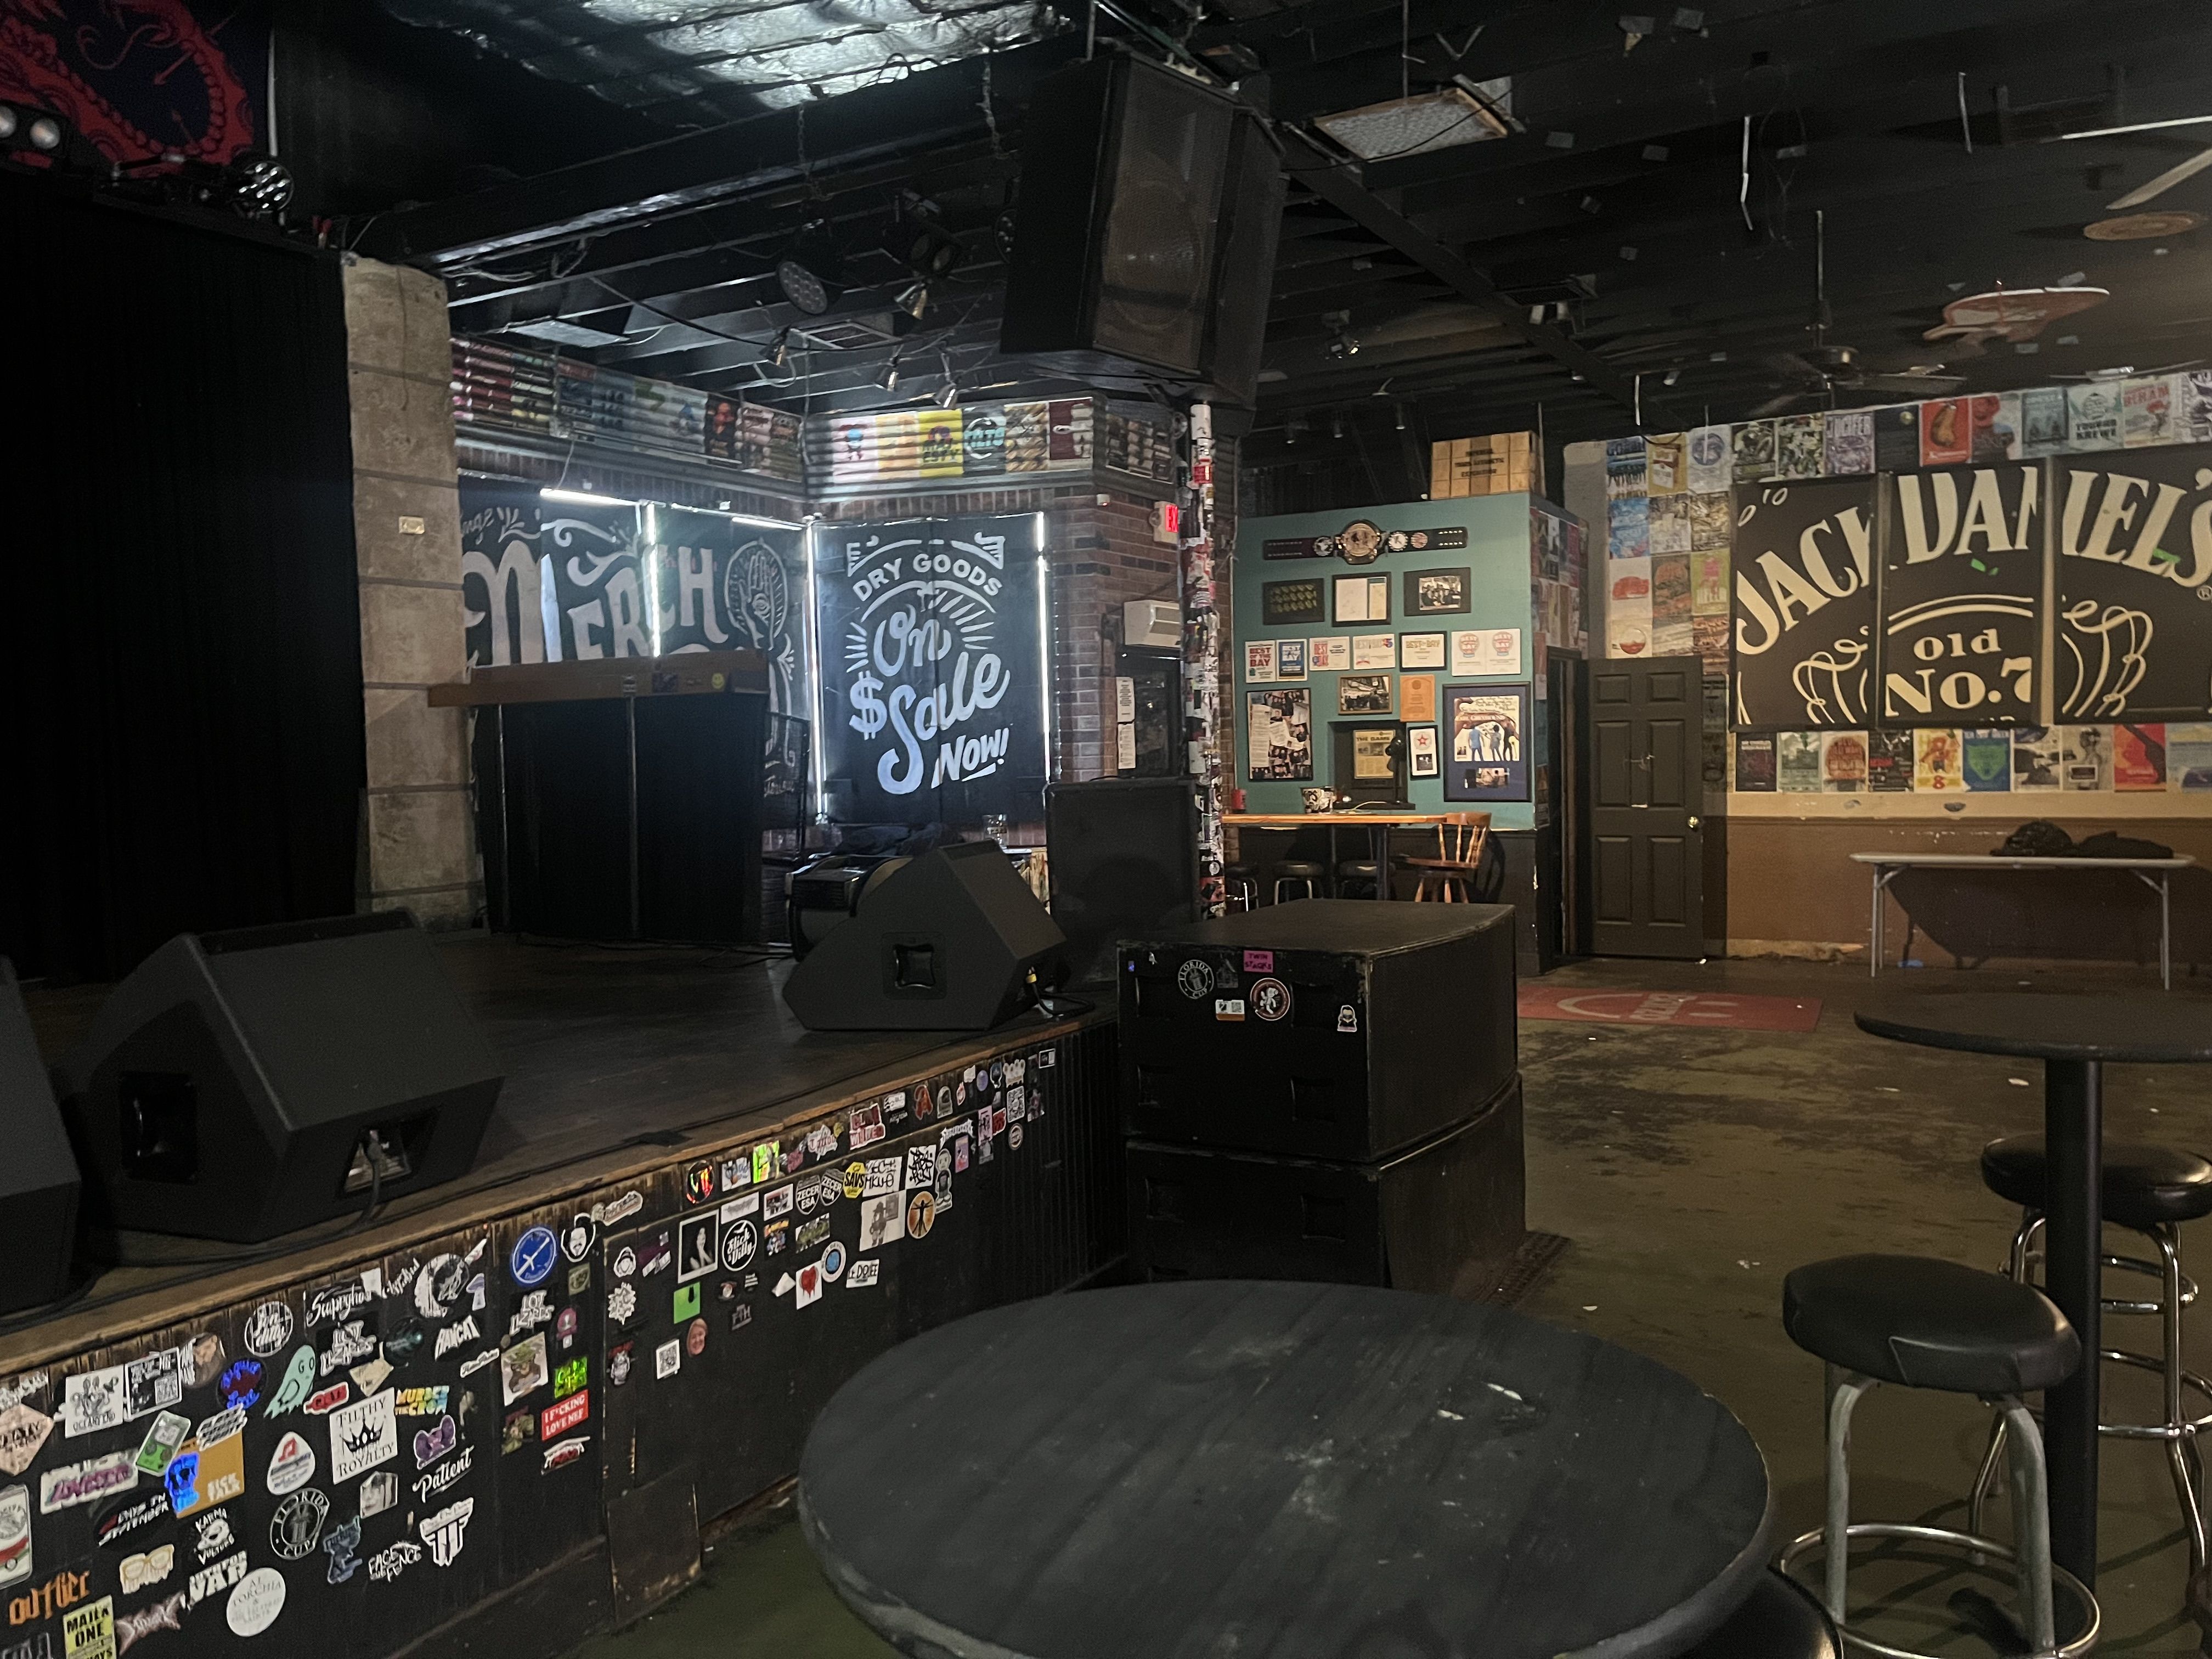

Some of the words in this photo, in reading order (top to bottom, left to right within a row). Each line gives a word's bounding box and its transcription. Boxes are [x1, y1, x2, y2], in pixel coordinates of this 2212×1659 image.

[853, 558, 902, 601] DRY
[913, 553, 1003, 596] GOODS
[462, 540, 729, 665] MERCH
[873, 604, 951, 676] On
[1180, 961, 1210, 981] FLORIDA
[1245, 961, 1272, 970] STACKS
[797, 1188, 820, 1200] ZECER
[801, 1197, 815, 1210] ESA
[336, 1396, 386, 1425] FILTHY
[546, 1416, 566, 1436] LOVE
[337, 1442, 395, 1478] ROYALTY
